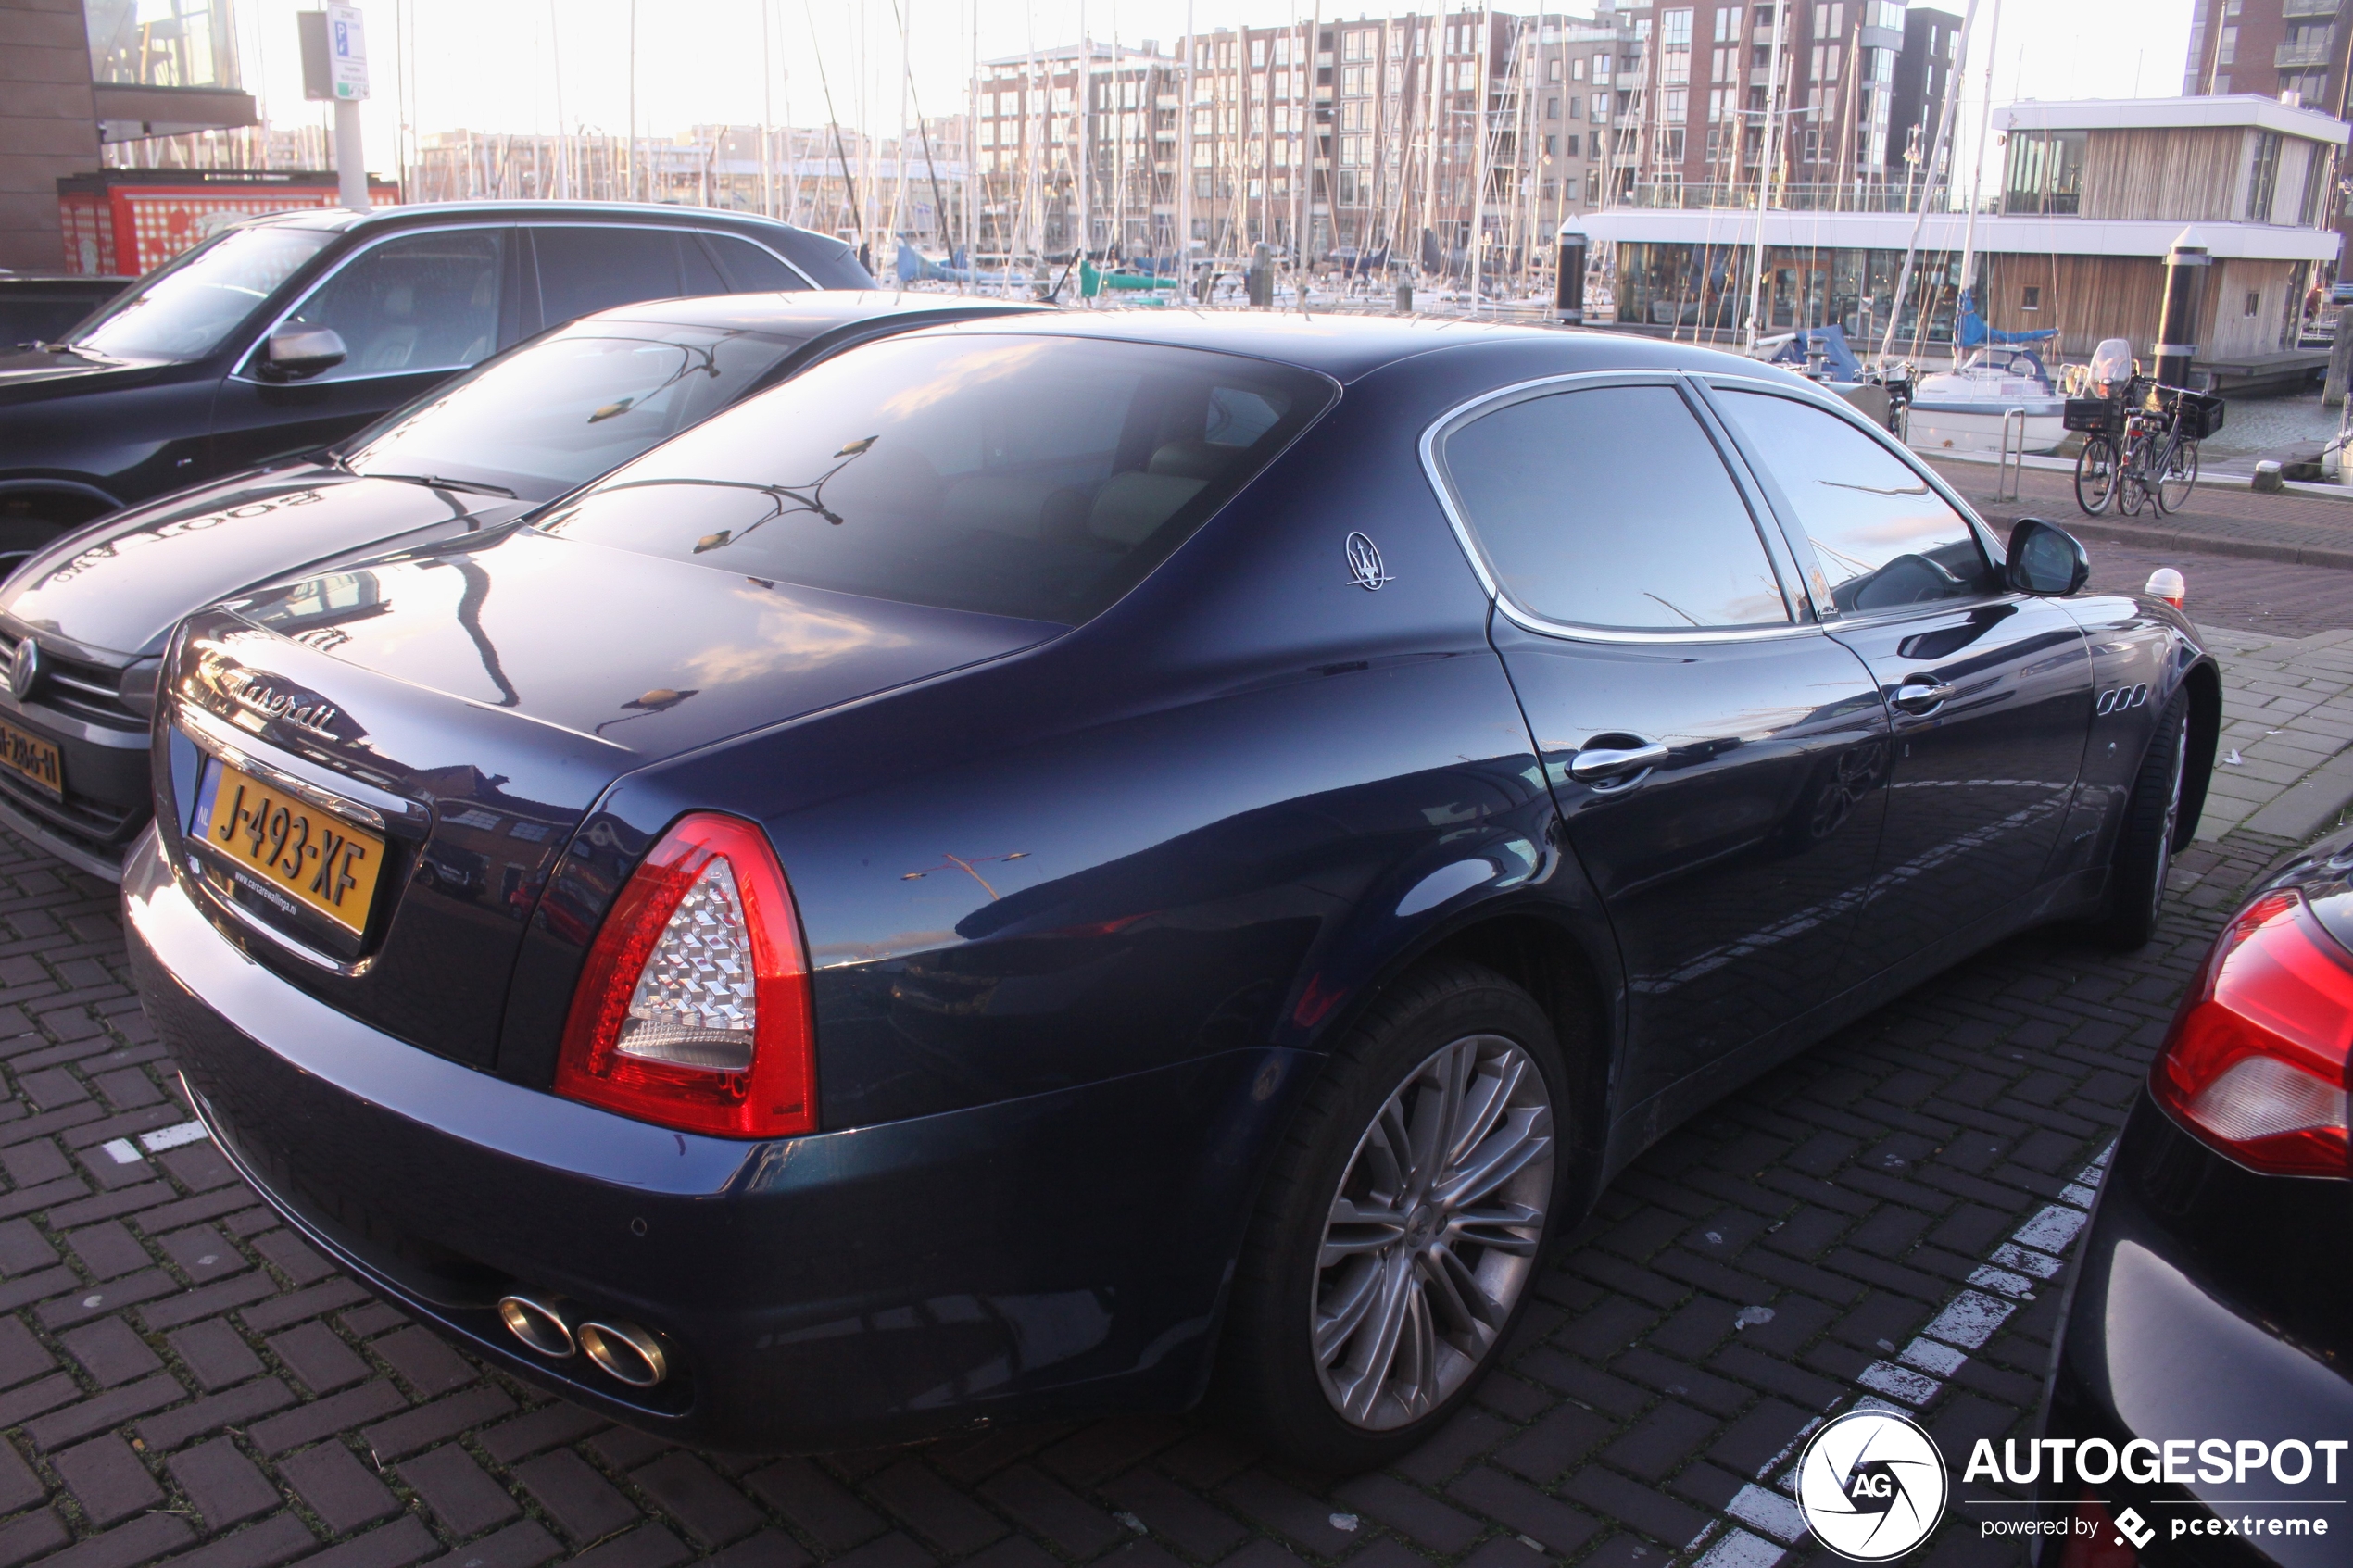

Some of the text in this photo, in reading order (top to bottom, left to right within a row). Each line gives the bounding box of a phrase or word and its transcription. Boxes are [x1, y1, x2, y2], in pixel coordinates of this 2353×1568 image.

[197, 805, 208, 827] NL
[219, 784, 366, 908] J-493-XF
[234, 871, 297, 916] www.carcarewallinga.nl
